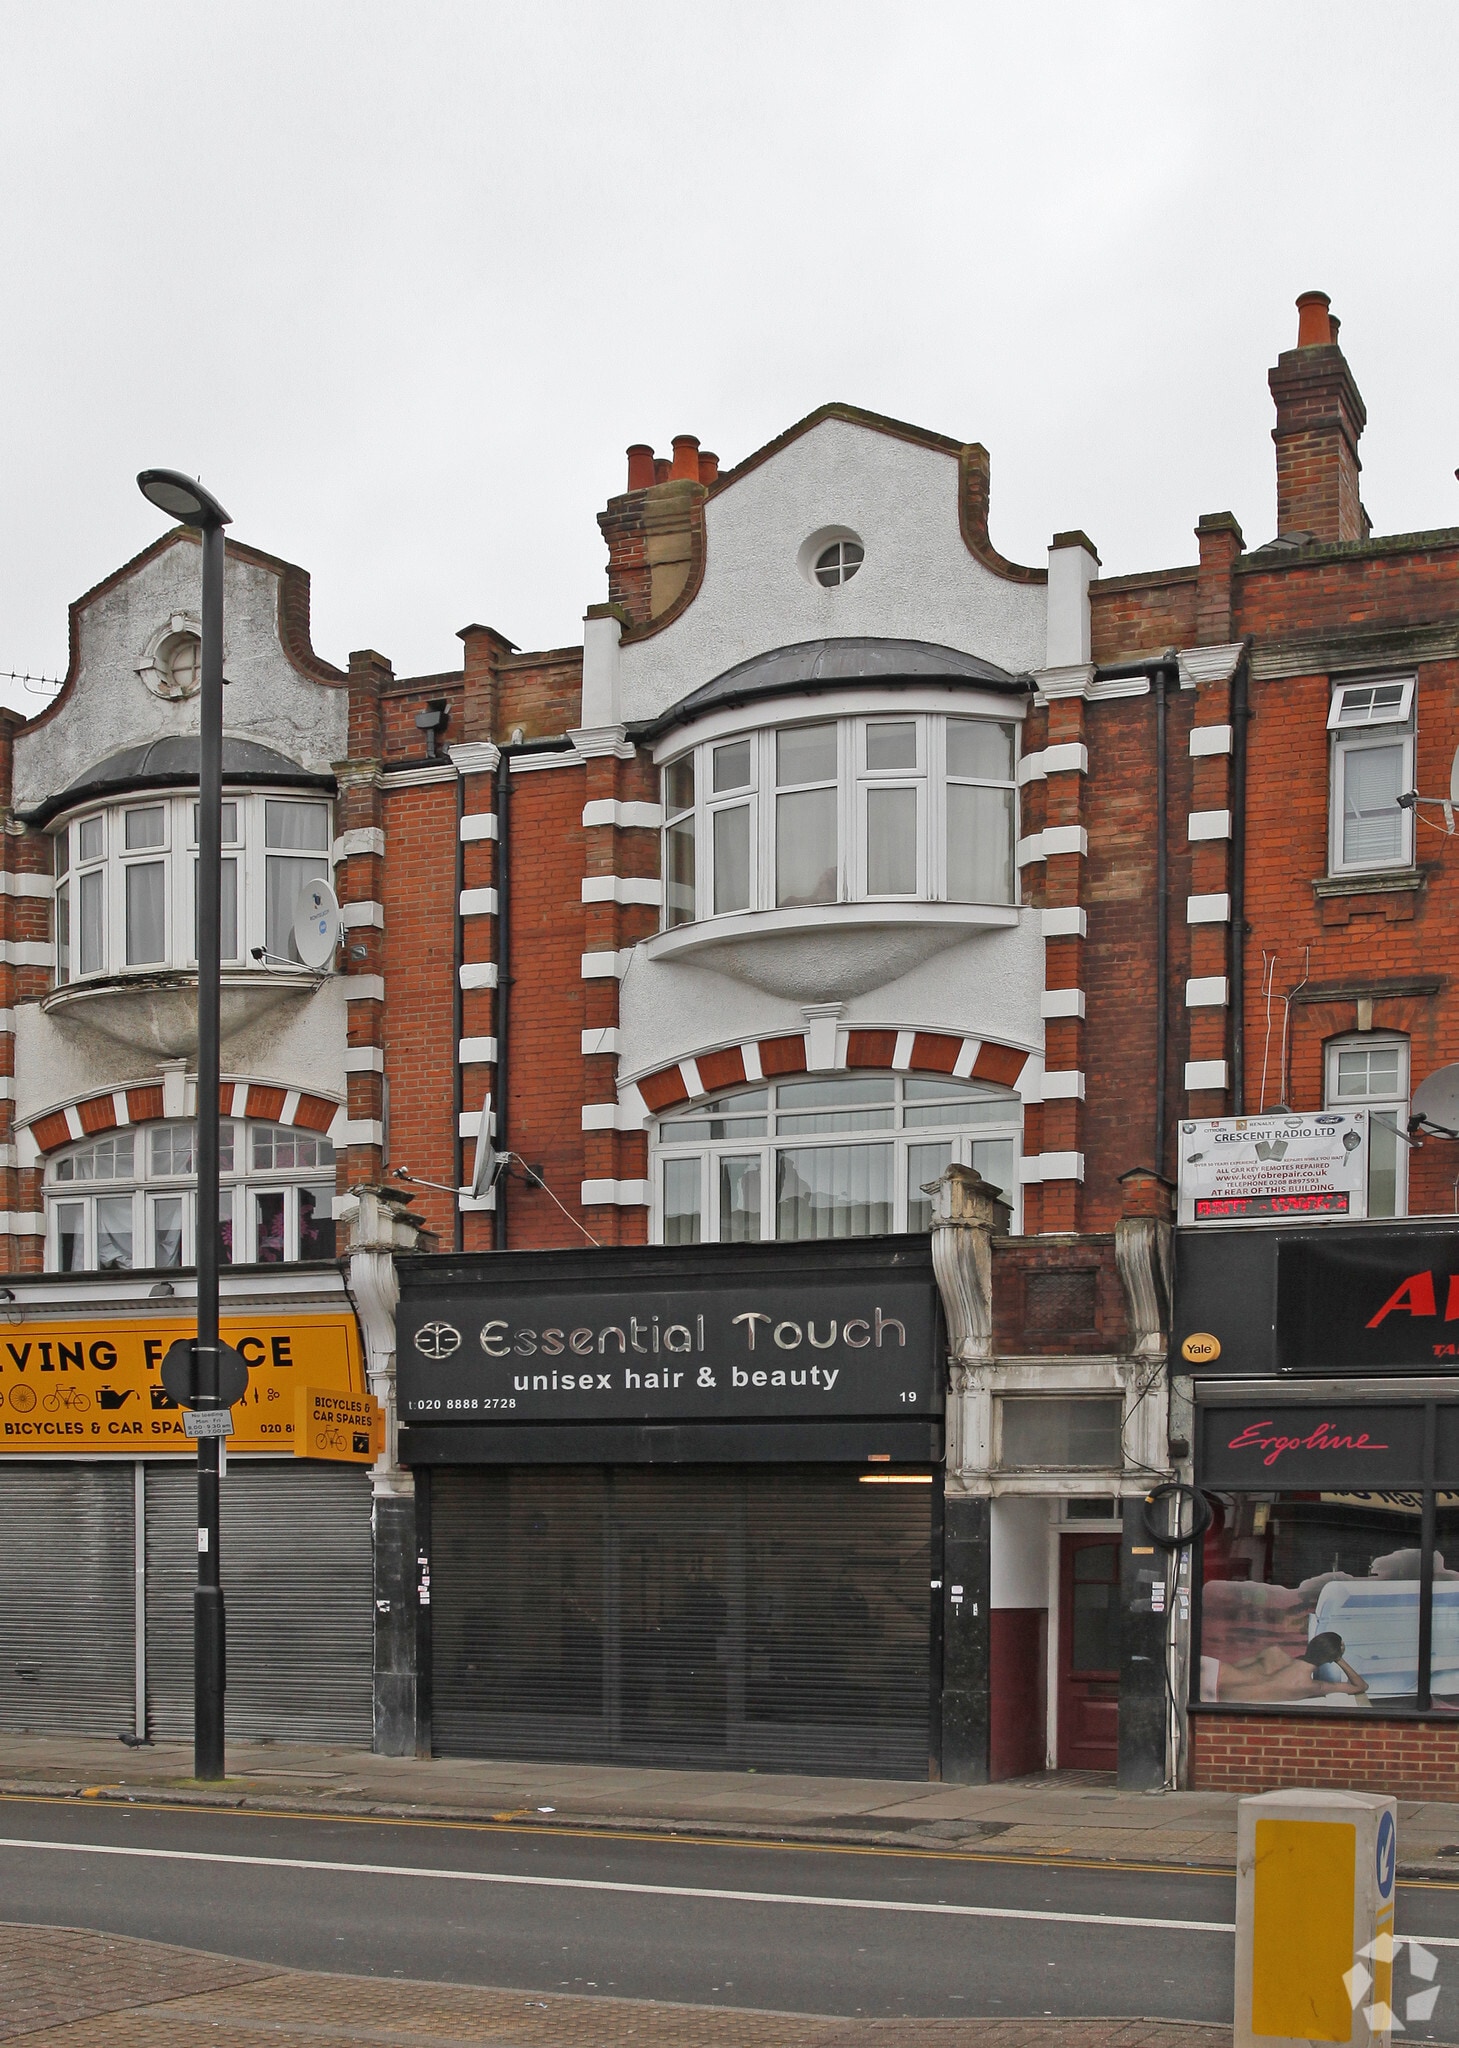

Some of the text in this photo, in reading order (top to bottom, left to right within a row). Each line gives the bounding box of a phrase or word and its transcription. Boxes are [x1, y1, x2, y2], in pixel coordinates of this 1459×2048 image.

[1214, 1127, 1336, 1142] CRESCENT RADIO LTD
[1215, 1169, 1328, 1182] www.keyfobrepair.co.uk
[1288, 1184, 1335, 1192] BUILDING
[479, 1306, 906, 1358] Essential Touch
[0, 1340, 118, 1372] VING
[1186, 1344, 1212, 1354] Yale
[1432, 1343, 1459, 1358] TA
[513, 1364, 840, 1391] unisex hair & beauty
[446, 1399, 479, 1410] 8888
[483, 1398, 517, 1409] 2728
[899, 1391, 917, 1402] 19
[314, 1396, 371, 1413] BICYCLES &
[313, 1410, 373, 1427] CAR SPARES
[4, 1422, 84, 1435] BICYCLES
[90, 1422, 101, 1434] &
[107, 1421, 144, 1434] CAR
[260, 1423, 282, 1433] 020
[1228, 1420, 1389, 1466] Ergoline
